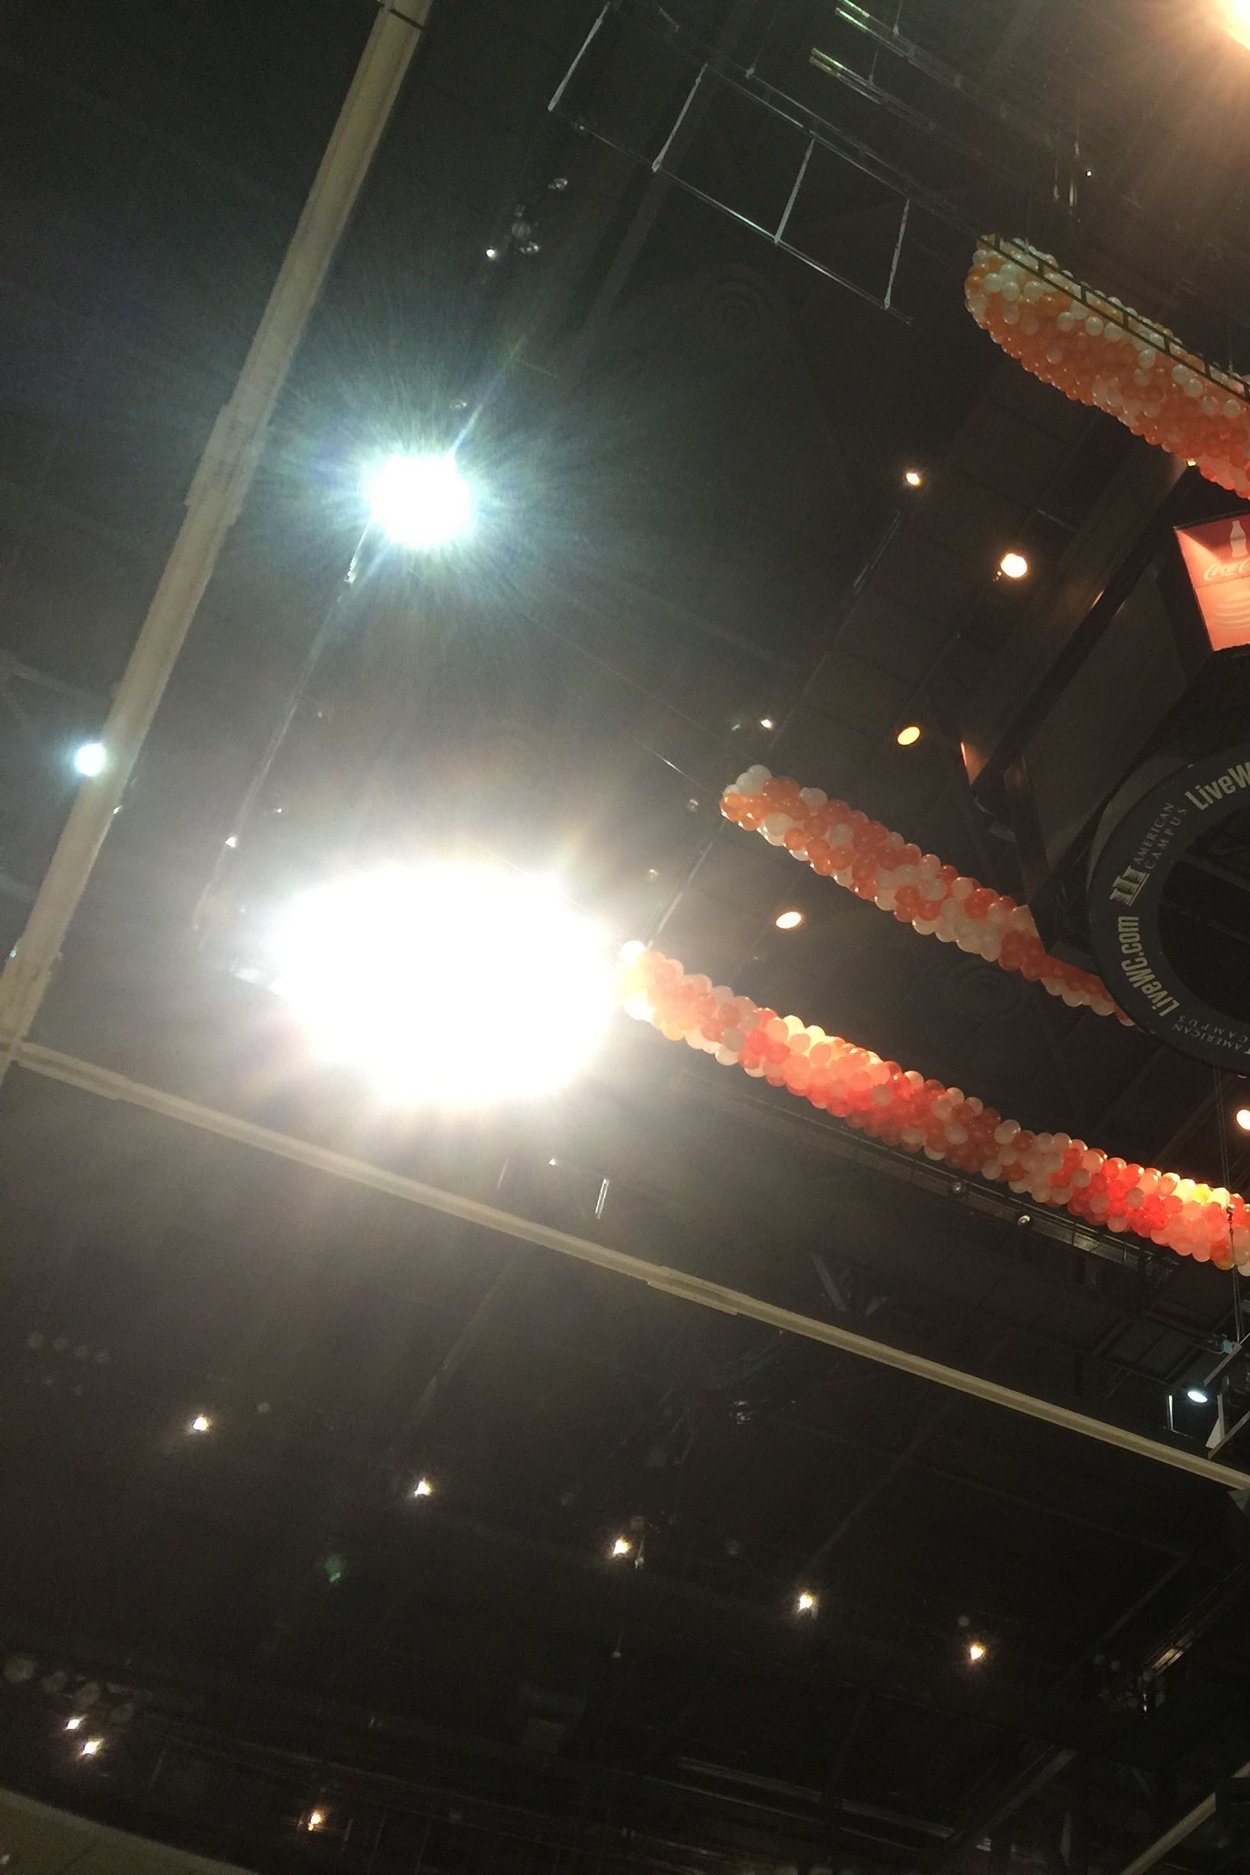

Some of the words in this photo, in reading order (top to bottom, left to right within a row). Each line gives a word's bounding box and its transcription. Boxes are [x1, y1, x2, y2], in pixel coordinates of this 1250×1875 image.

[1133, 802, 1174, 865] AMERICAN
[1145, 807, 1187, 870] CAMPUS
[1118, 916, 1180, 1016] LiveWC.com
[1172, 1023, 1244, 1050] AMERICAN
[1177, 1015, 1248, 1043] CAMPUS
